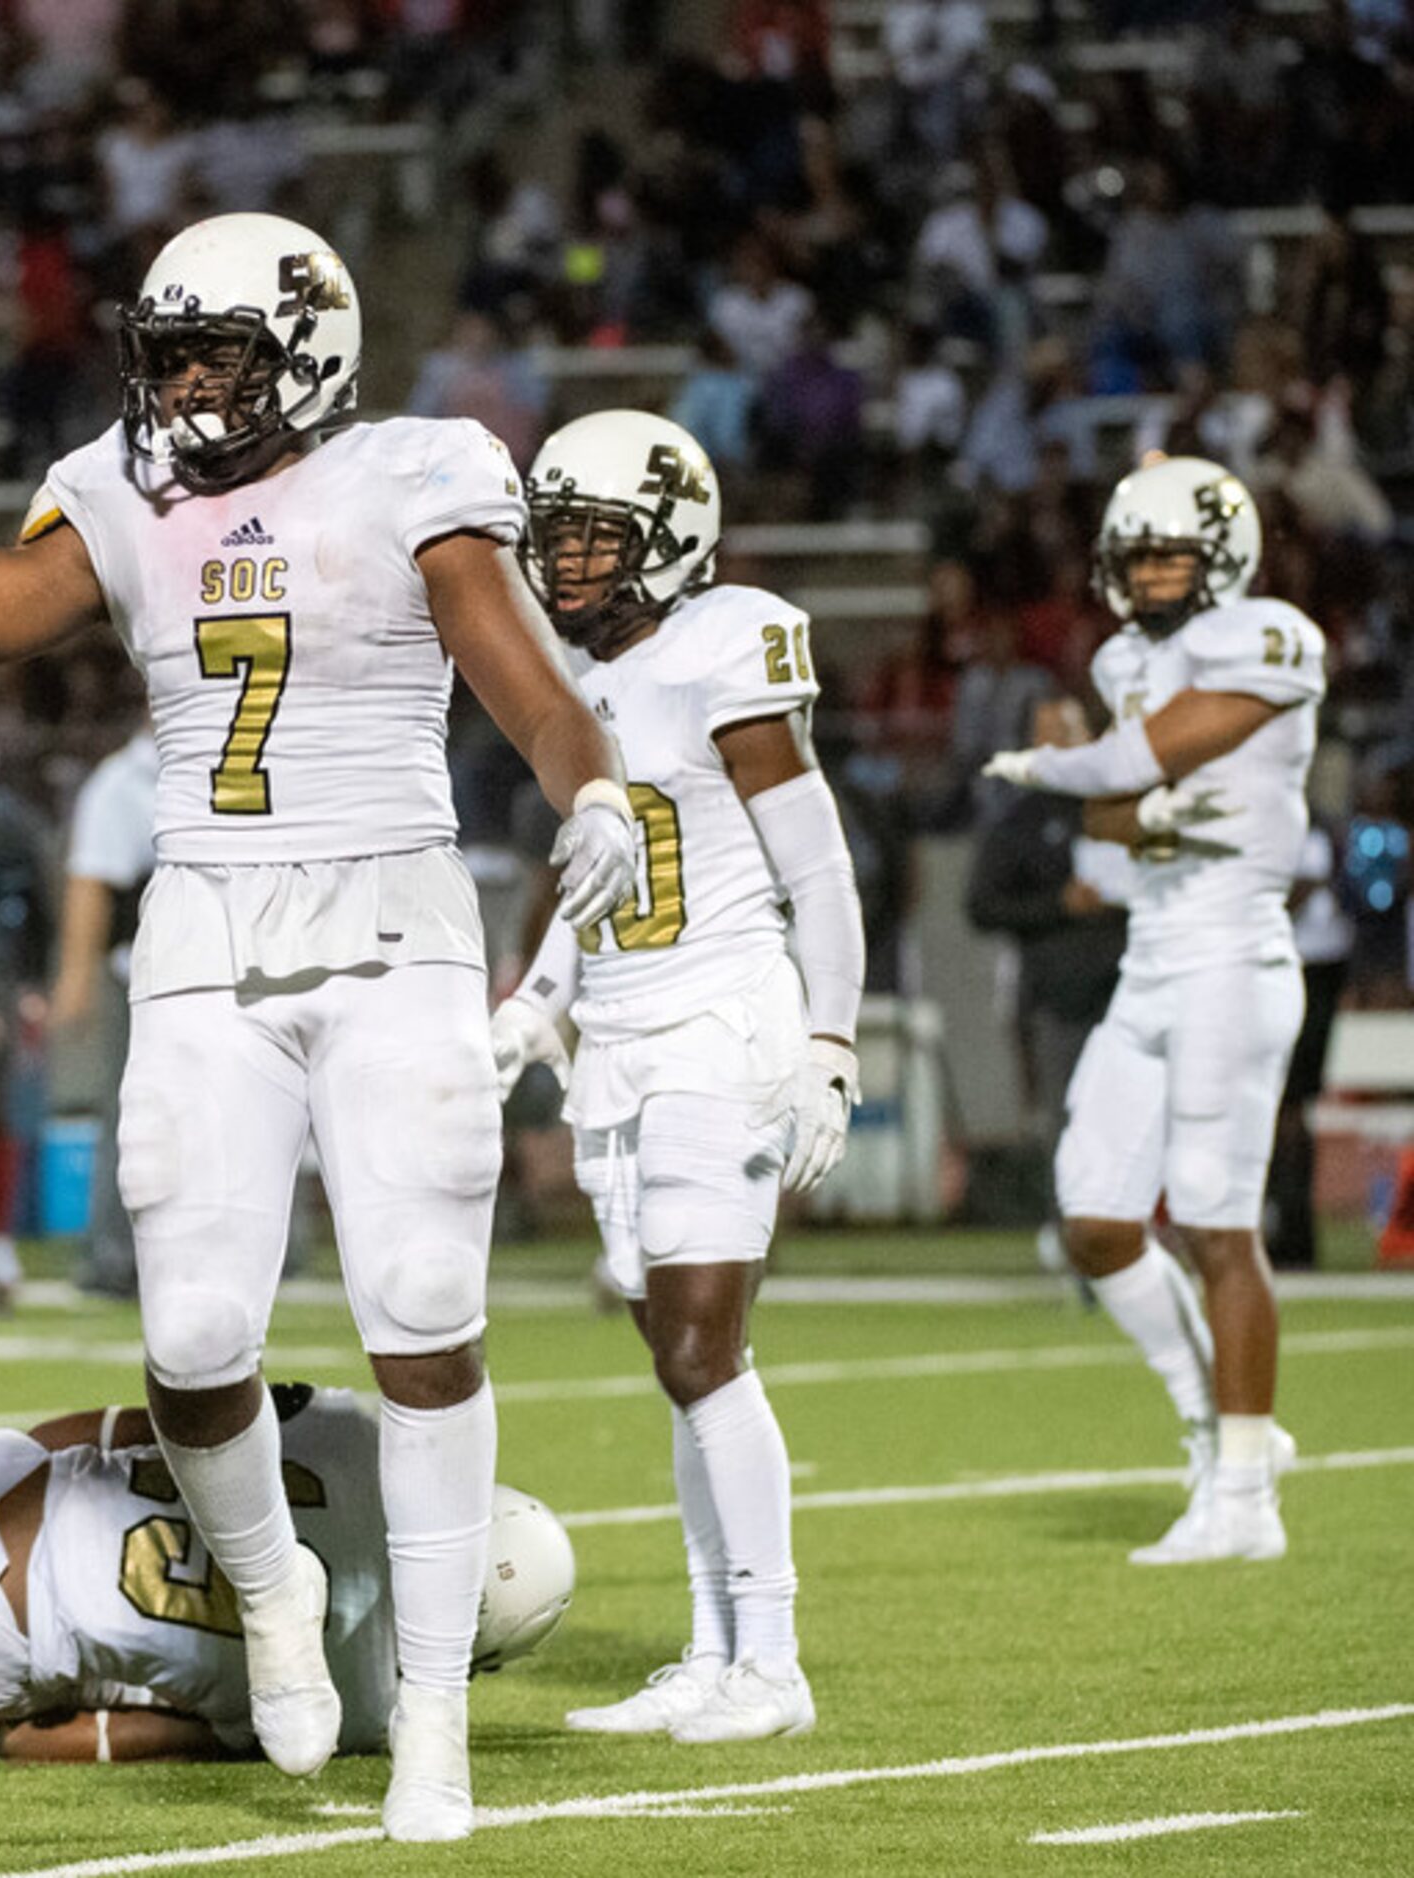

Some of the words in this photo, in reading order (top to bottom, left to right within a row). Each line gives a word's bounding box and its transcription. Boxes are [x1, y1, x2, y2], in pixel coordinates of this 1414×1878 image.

[200, 556, 289, 604] SOC
[220, 534, 274, 547] adidas
[193, 611, 291, 814] 7
[576, 781, 688, 955] 0
